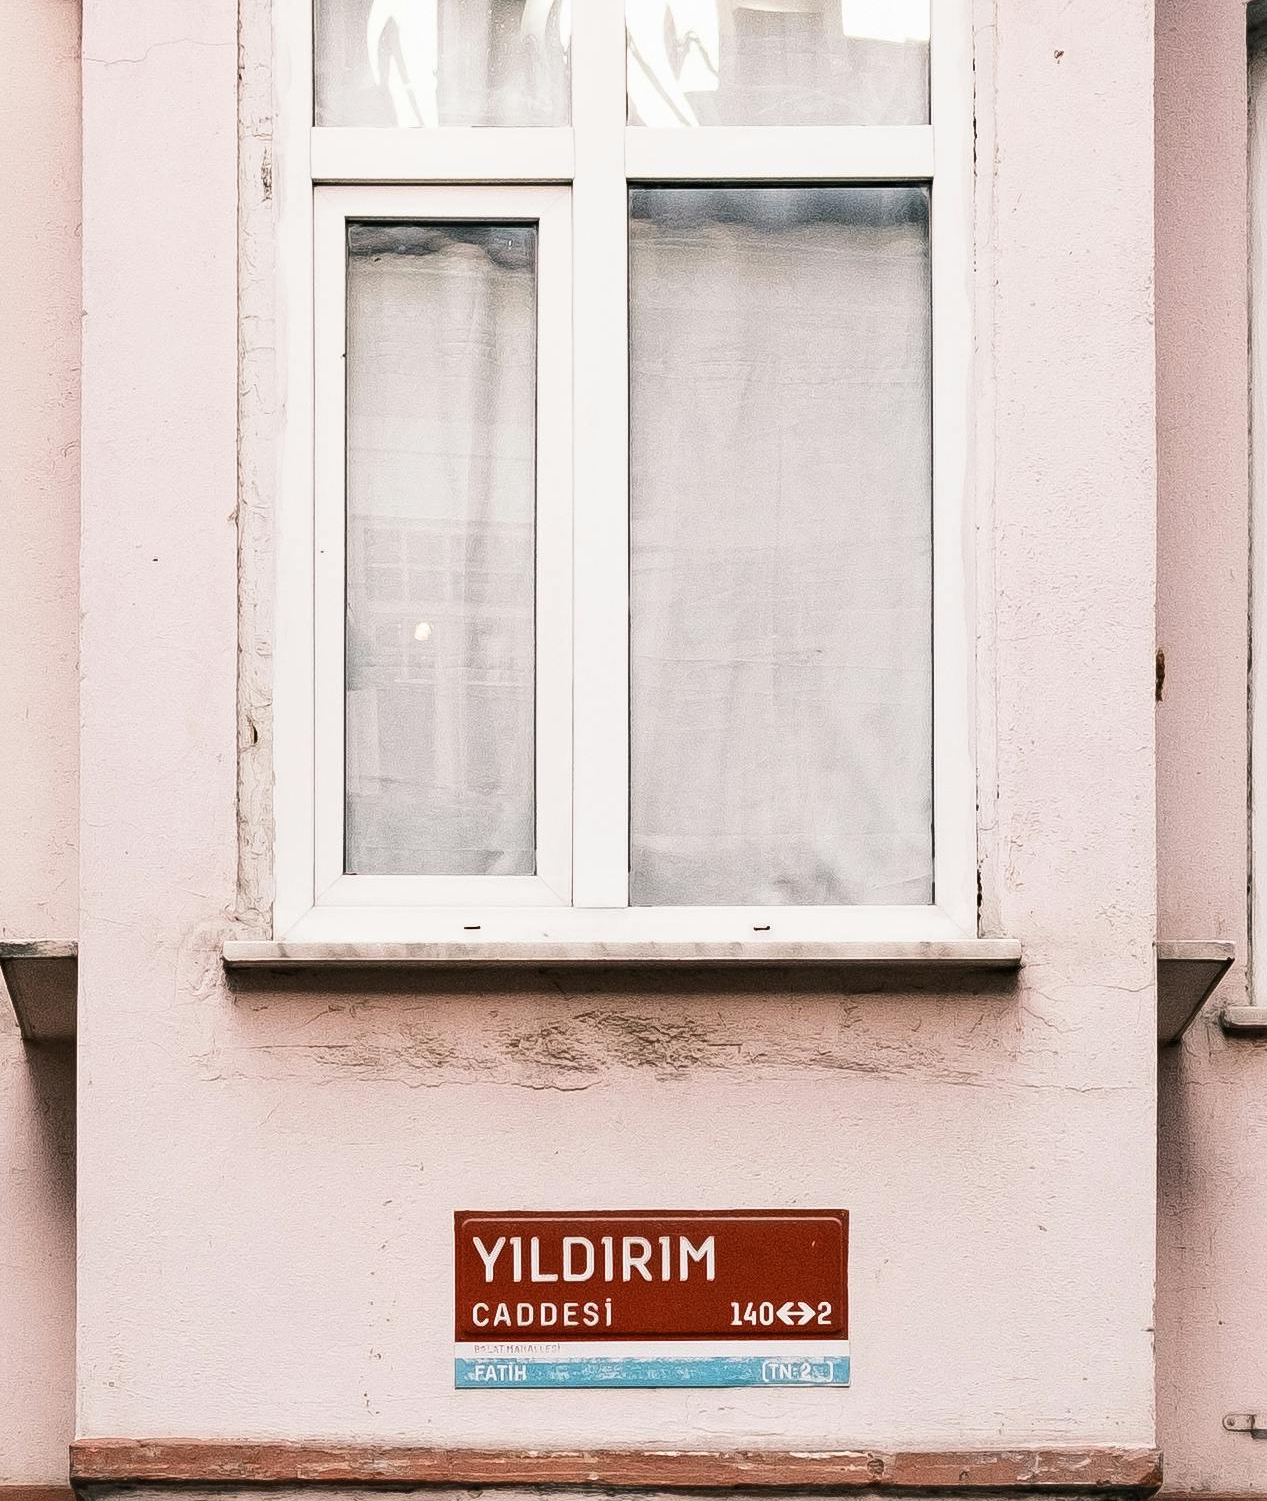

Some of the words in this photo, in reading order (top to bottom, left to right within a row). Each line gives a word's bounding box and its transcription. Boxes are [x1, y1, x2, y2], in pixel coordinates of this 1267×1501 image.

[472, 1236, 716, 1283] YILDIRIM
[471, 1298, 613, 1327] CADDESİ
[474, 1362, 527, 1381] FATİH
